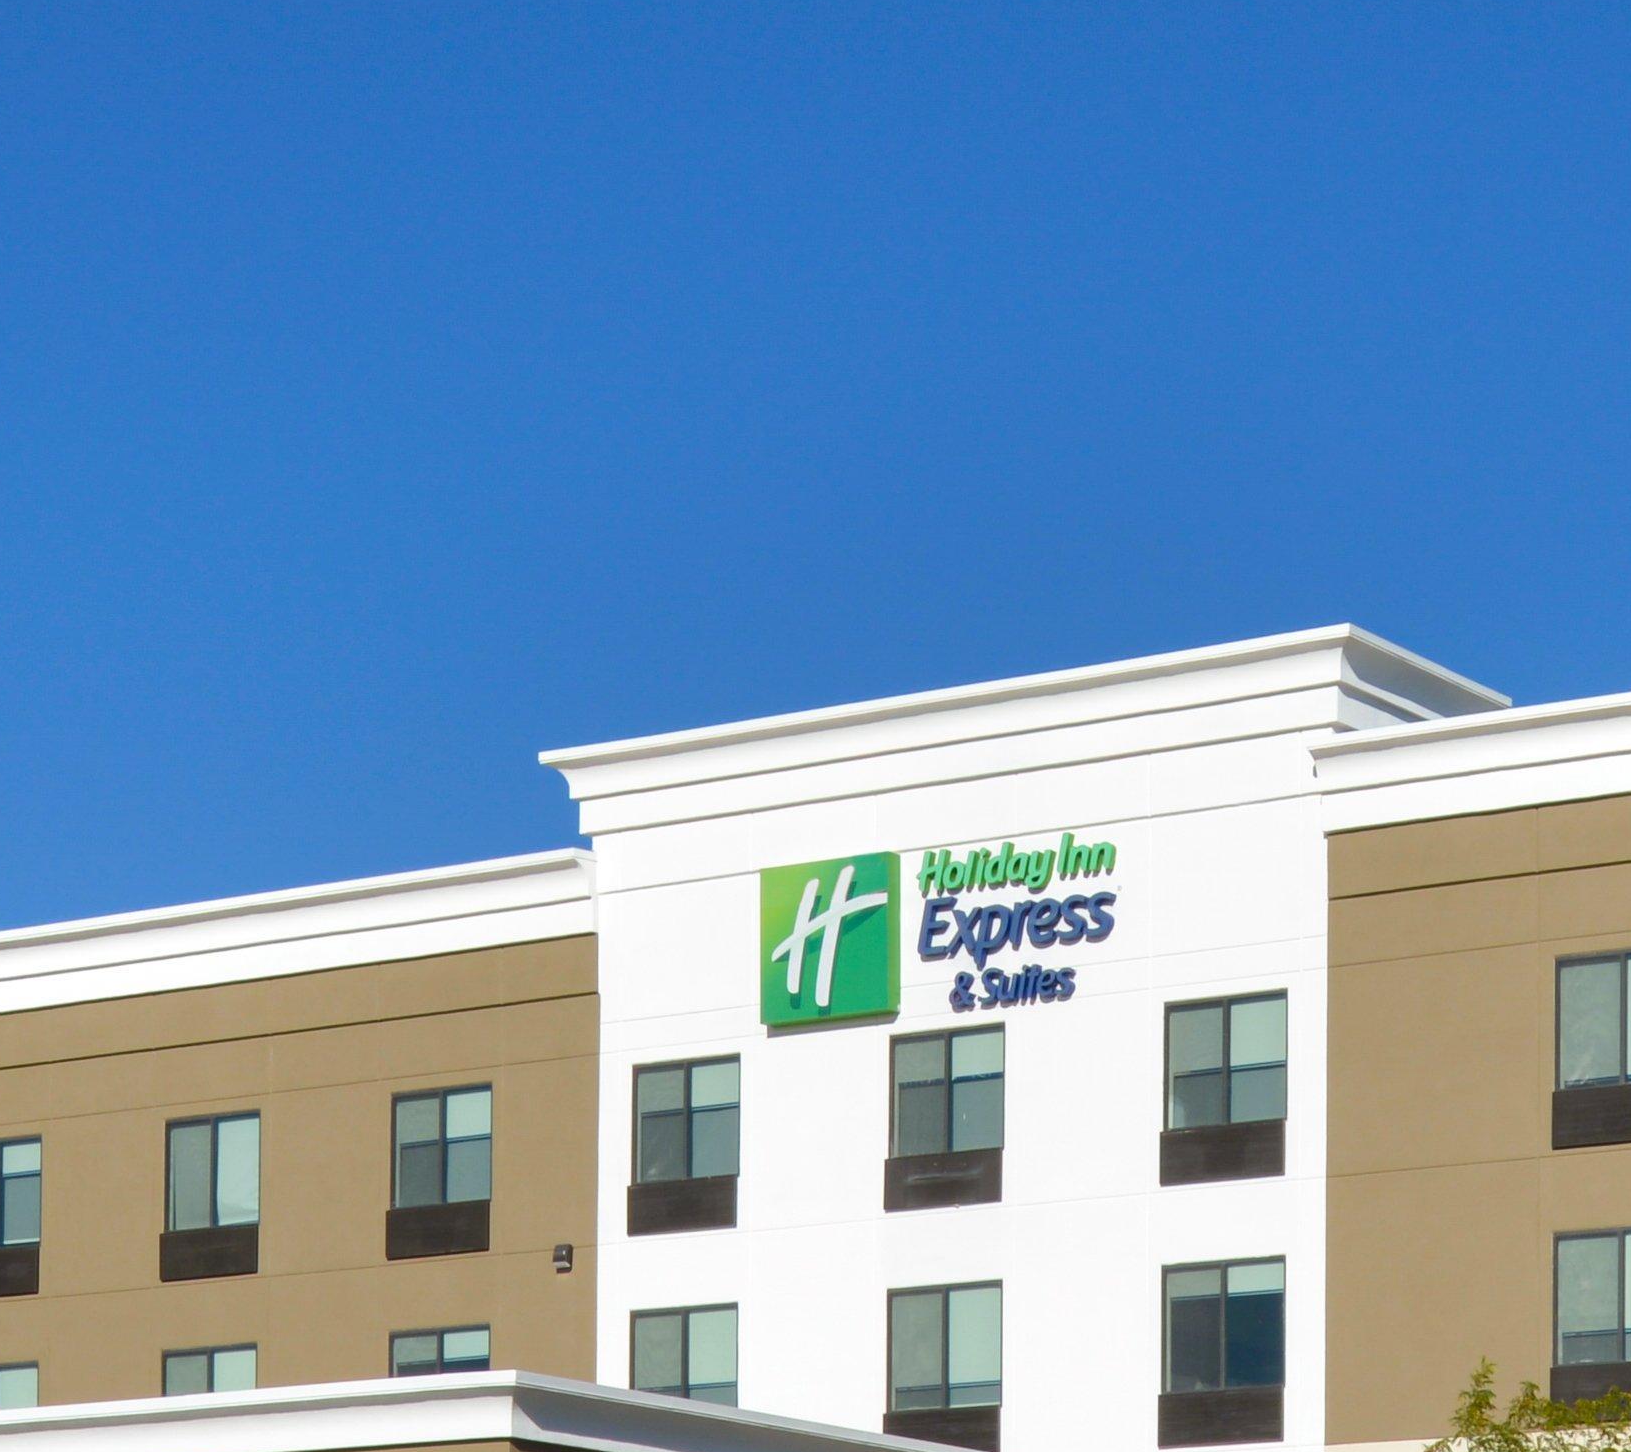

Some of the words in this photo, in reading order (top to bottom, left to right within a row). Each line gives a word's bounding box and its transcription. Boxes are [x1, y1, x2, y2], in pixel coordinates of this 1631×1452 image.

[917, 841, 1057, 896] Holiday
[1056, 832, 1117, 880] Inn
[918, 891, 1117, 970] Express
[948, 971, 976, 1012] &
[978, 963, 1077, 1010] Suites
